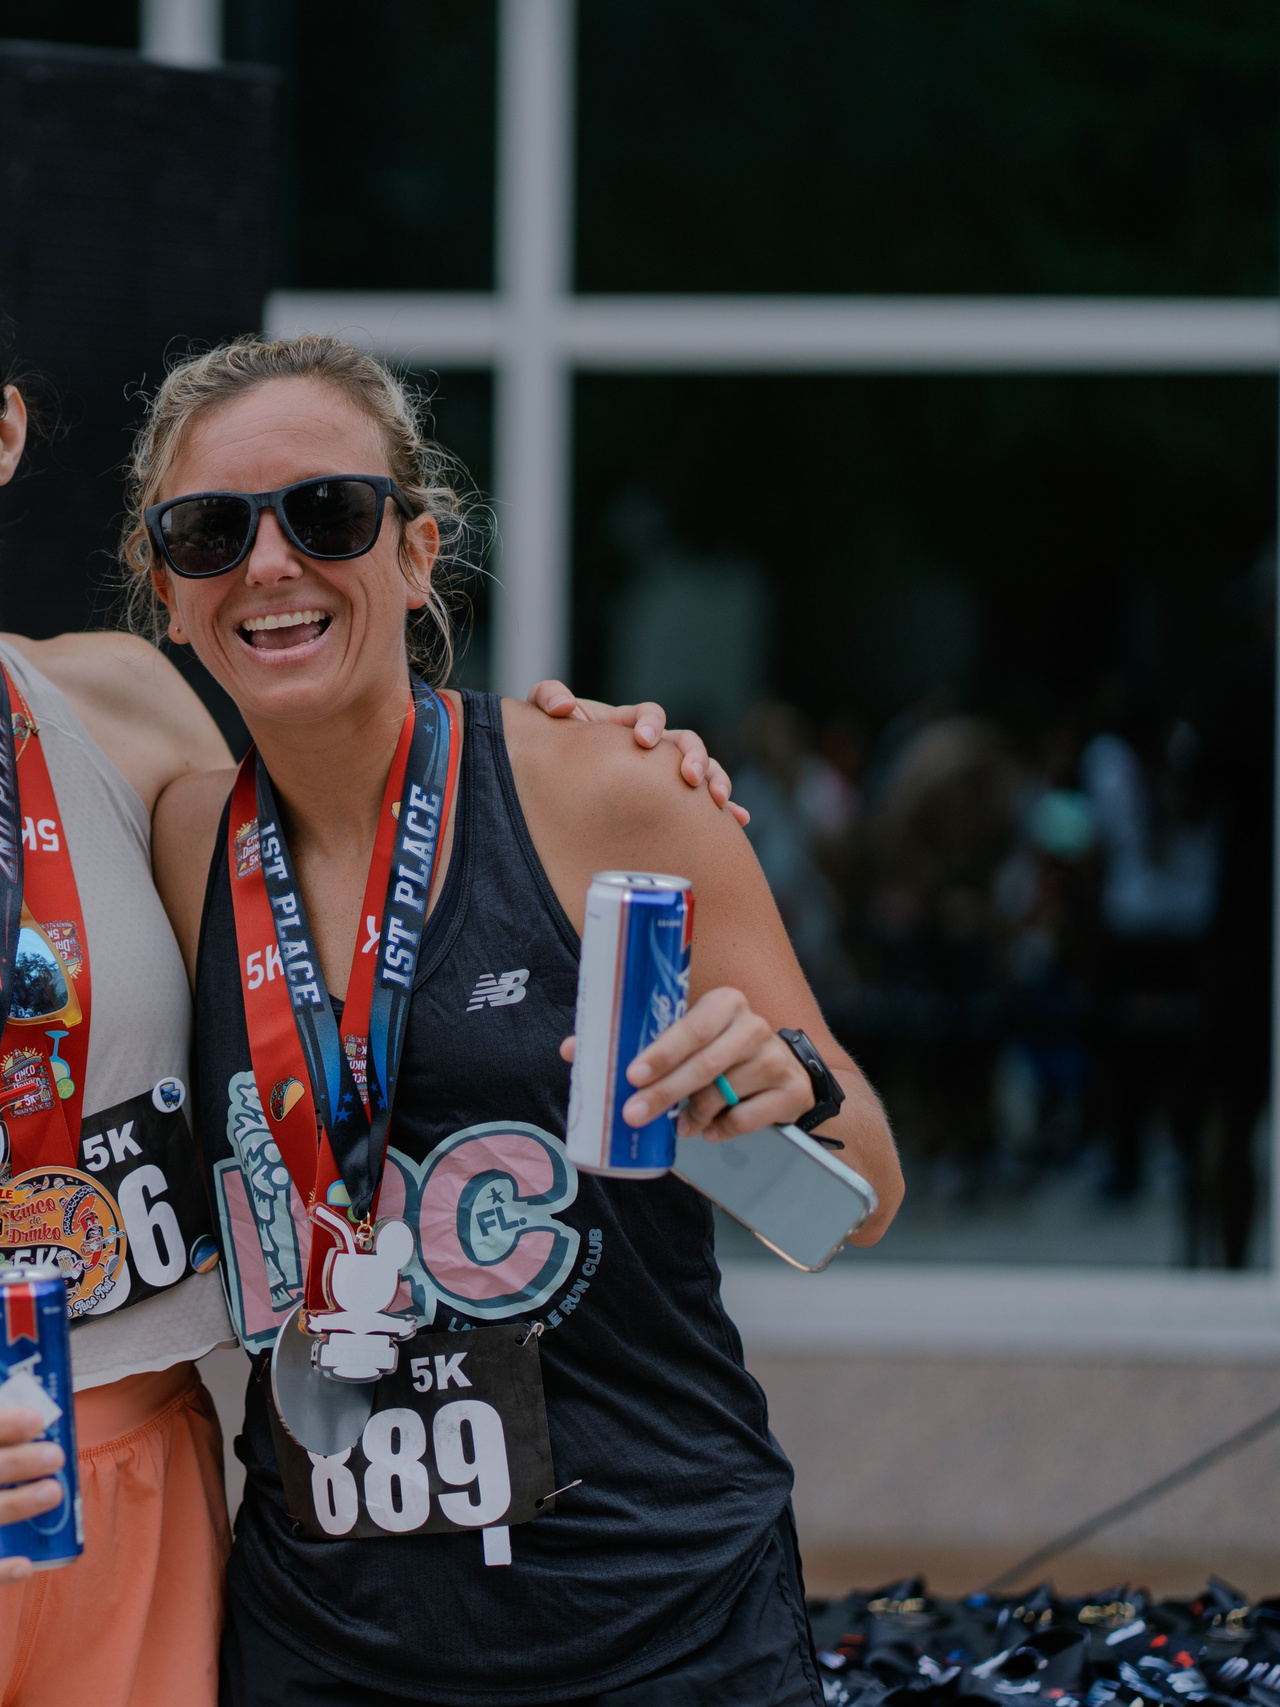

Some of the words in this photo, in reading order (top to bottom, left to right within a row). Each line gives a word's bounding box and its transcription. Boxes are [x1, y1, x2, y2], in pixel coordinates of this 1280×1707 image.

[258, 821, 289, 881] 1ST
[392, 783, 443, 914] PLACE
[269, 891, 323, 1009] PLACE
[381, 917, 421, 990] 1ST
[14, 1064, 36, 1082] CINCO
[82, 1120, 143, 1172] 5K
[3, 1197, 57, 1222] Cinco
[5, 1222, 62, 1244] Drinko
[29, 1215, 43, 1225] de
[475, 1204, 529, 1238] FL.
[558, 1278, 591, 1316] RUN
[581, 1228, 603, 1277] CLUB
[74, 1295, 99, 1316] Taco
[409, 1352, 473, 1394] 5K
[306, 1399, 513, 1537] 889
